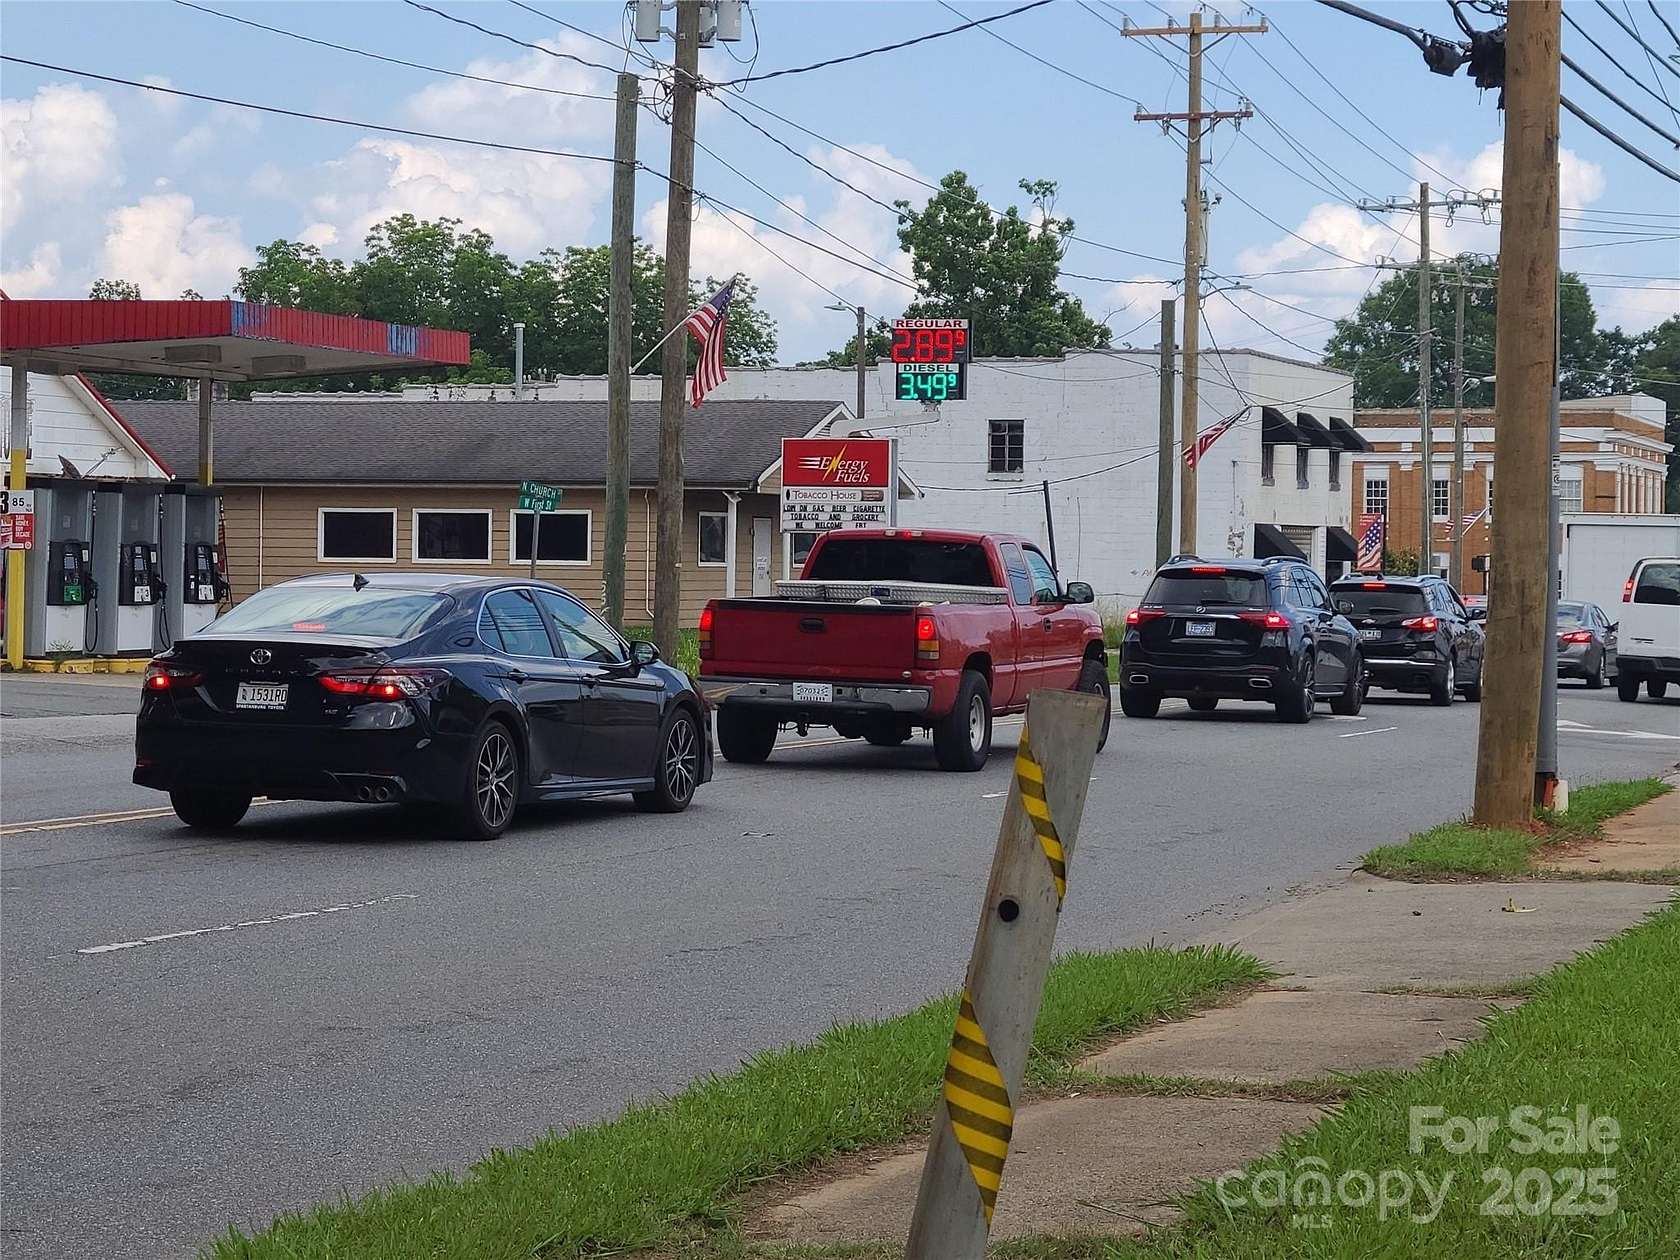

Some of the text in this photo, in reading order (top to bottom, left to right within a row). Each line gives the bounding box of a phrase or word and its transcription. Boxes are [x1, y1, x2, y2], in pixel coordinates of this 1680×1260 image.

[896, 320, 963, 328] REGULAR
[903, 364, 954, 372] DIESEL
[833, 468, 870, 483] Fuels
[522, 482, 557, 499] N CHURCH
[12, 497, 25, 506] 85
[853, 505, 886, 513] CIGARETTE
[852, 513, 879, 521] GROCERY
[250, 688, 287, 702] 1531RD
